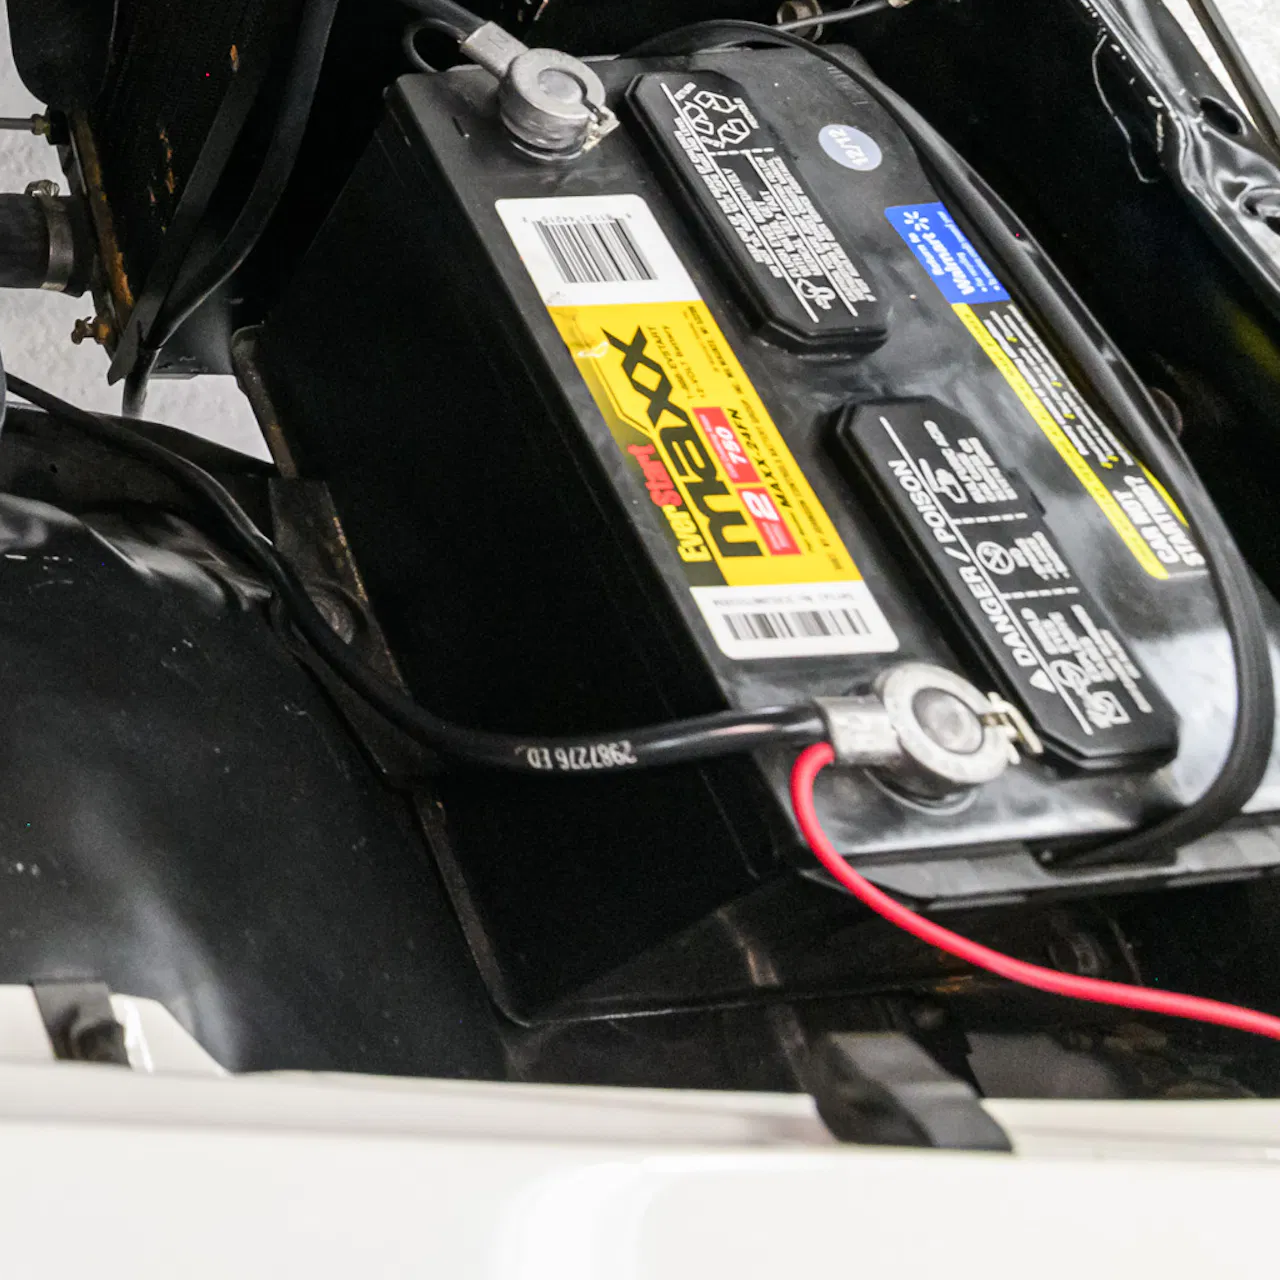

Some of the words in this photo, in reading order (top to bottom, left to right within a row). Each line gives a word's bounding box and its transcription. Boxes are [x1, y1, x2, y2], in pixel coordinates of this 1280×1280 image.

[827, 127, 869, 166] 12/12
[758, 189, 782, 212] FAST
[773, 212, 798, 236] HELP
[904, 231, 922, 243] to
[774, 248, 802, 278] FLUSH
[914, 243, 946, 276] Return
[919, 231, 979, 295] Walmart
[712, 425, 750, 465] 750
[921, 419, 950, 447] ACID
[726, 406, 792, 508] MAXX-24FN
[625, 442, 714, 562] EverStart
[738, 489, 781, 521] 2
[885, 457, 958, 543] POISON
[1110, 487, 1153, 525] NOT
[1120, 472, 1208, 567] STARTING?
[1137, 524, 1182, 564] CAR
[955, 565, 1039, 666] DANGER
[554, 740, 638, 771] 2987276
